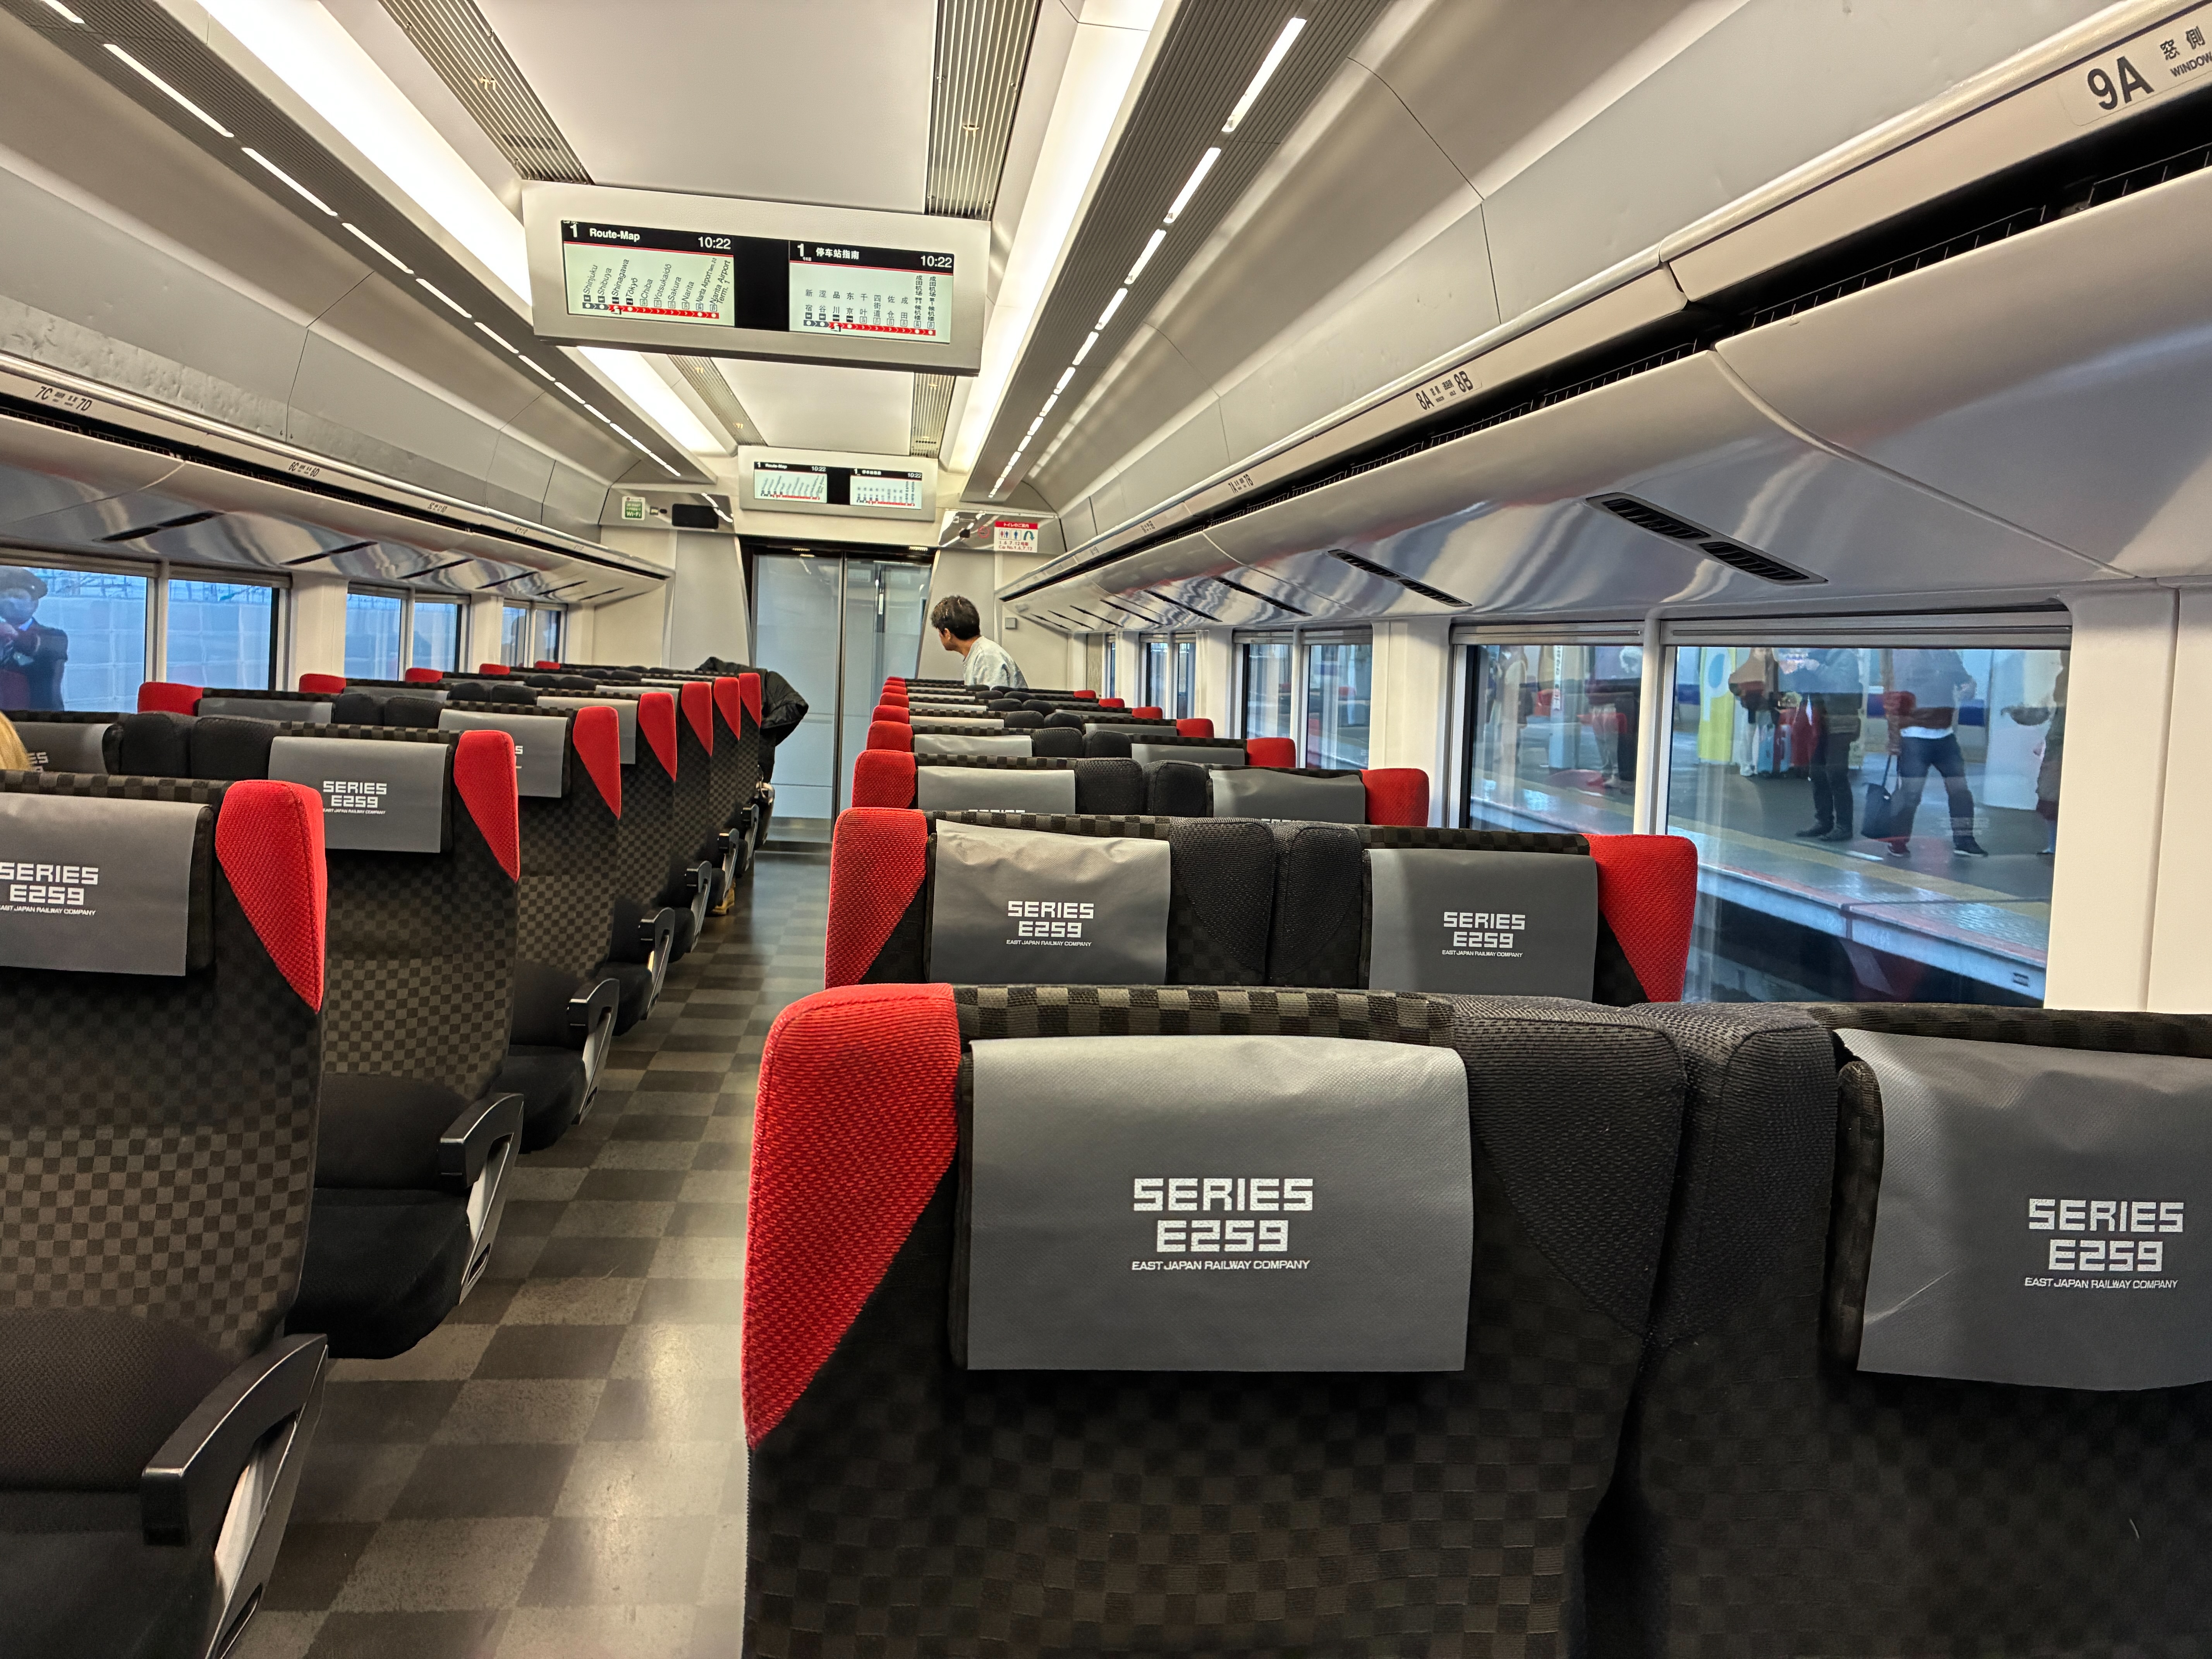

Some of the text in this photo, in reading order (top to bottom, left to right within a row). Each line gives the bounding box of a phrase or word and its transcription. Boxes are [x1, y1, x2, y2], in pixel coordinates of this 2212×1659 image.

[2160, 25, 2205, 60] 窓側
[2170, 52, 2212, 77] WINDOW
[2088, 56, 2155, 110] 9A
[570, 224, 731, 249] 1 Route-Map 10:22
[797, 243, 804, 257] 1
[816, 247, 859, 259] 停车站指南
[921, 255, 952, 268] 10:22
[583, 265, 598, 294] Shinjuku
[598, 268, 612, 295] Shibuya
[612, 259, 629, 296] Shinagawa
[709, 284, 722, 304] Narita
[718, 260, 731, 283] Airport
[641, 279, 653, 299] Chiba
[668, 277, 682, 301] Sakura
[682, 282, 694, 302] Narita
[716, 287, 728, 304] Term.
[805, 289, 813, 311] 新宿
[833, 291, 840, 314] 品川
[846, 292, 854, 315] 东京
[860, 294, 868, 316] 千叶
[888, 295, 895, 318] 佐仓
[901, 297, 908, 319] 成田
[1454, 371, 1473, 392] 8B
[35, 386, 53, 400] 7C
[76, 398, 93, 411] 7D
[1416, 390, 1434, 410] 8A
[289, 462, 299, 471] 6C
[1243, 474, 1254, 487] 7B
[323, 781, 387, 795] SERIES
[331, 795, 378, 808] E259
[0, 862, 98, 885] SERIES
[10, 884, 84, 905] E259
[1008, 901, 1094, 919] SERIES
[1444, 912, 1525, 930] SERIES
[1018, 921, 1082, 938] E259
[1453, 931, 1513, 948] E259
[1133, 1178, 1313, 1211] SERIES
[2029, 1199, 2184, 1232] SERIES
[1157, 1220, 1288, 1252] E259
[1132, 1260, 1310, 1270] EAST JAPAN RAILWAY COMPANY
[2049, 1239, 2163, 1272] E259
[2025, 1277, 2178, 1289] EAST JAPAN RAILWAY COMPANY
